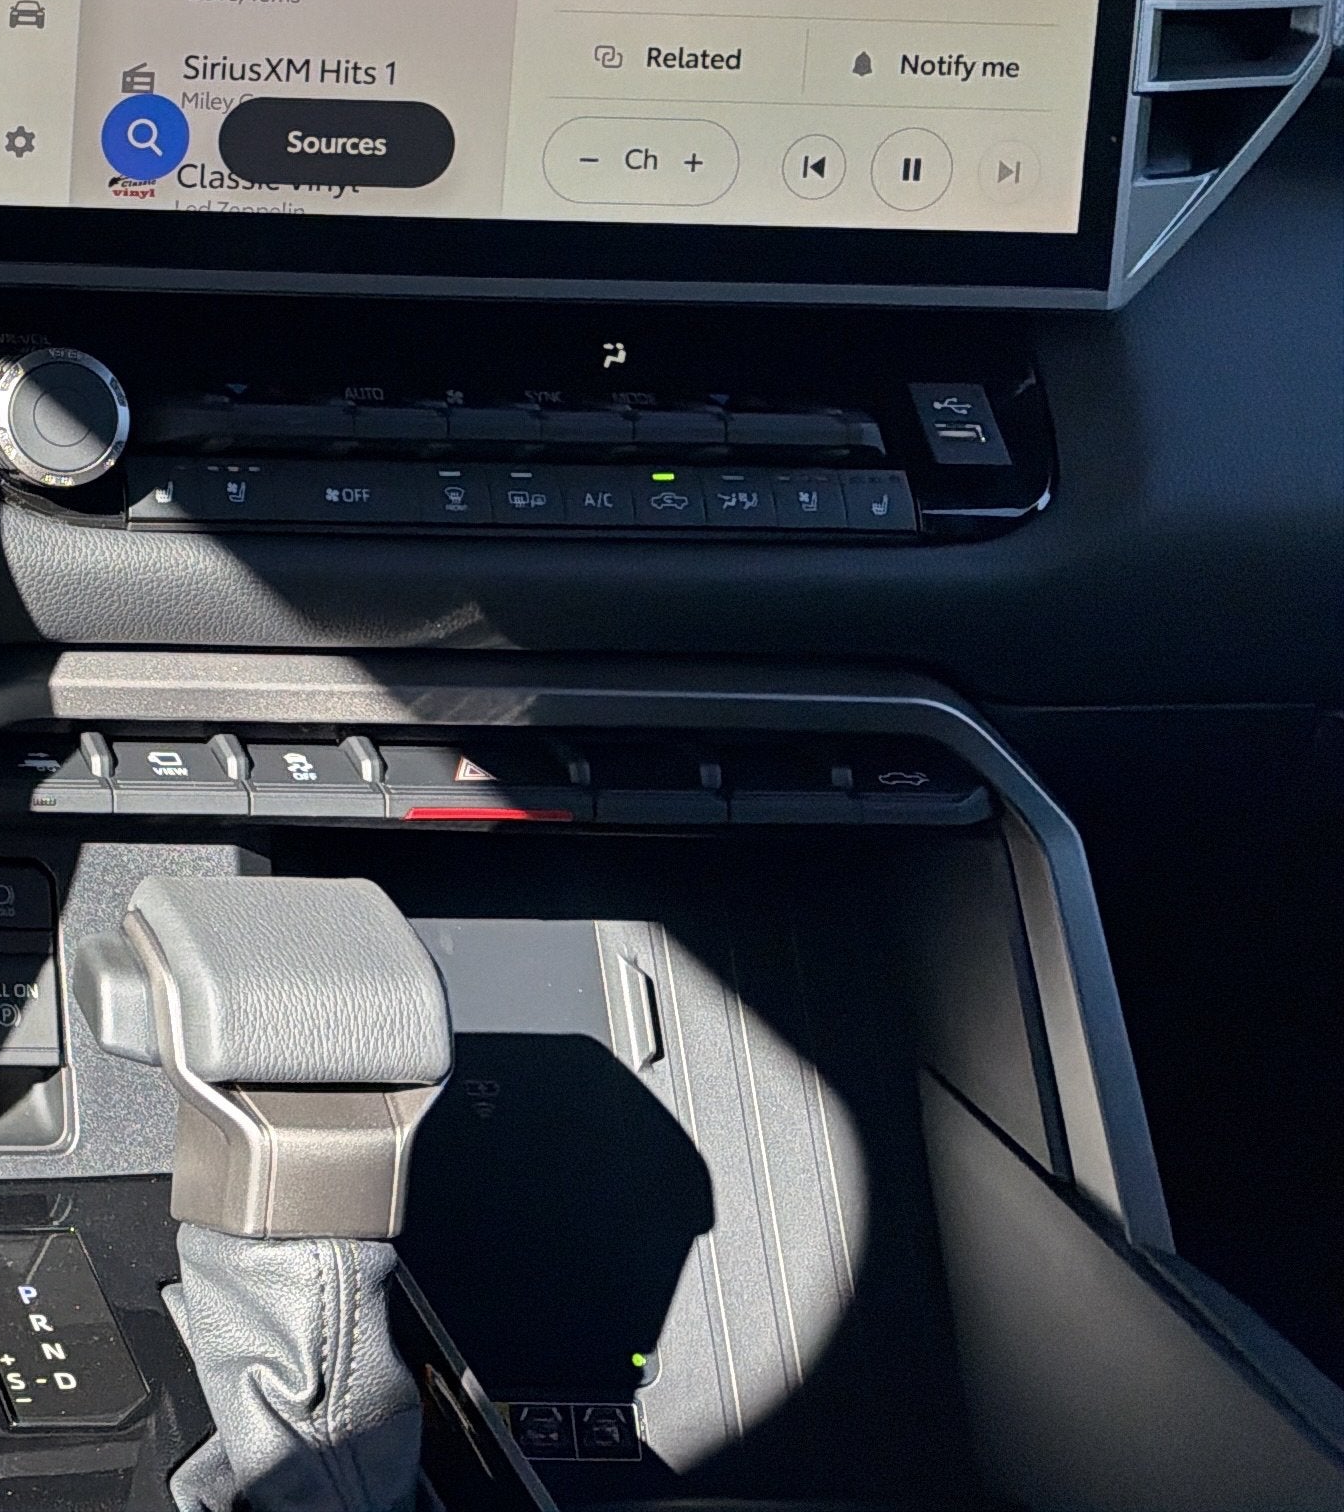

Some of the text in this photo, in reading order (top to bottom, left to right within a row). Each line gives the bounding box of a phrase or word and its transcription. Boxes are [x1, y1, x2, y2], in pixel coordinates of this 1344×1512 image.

[182, 54, 398, 86] SiriusXM Hits 1
[646, 46, 1021, 80] Related Notify me
[181, 91, 234, 115] Miley
[286, 130, 387, 156] Sources
[624, 148, 659, 171] Ch
[111, 188, 156, 199] vinyl
[344, 387, 385, 401] AUTO
[342, 489, 371, 504] OFF
[584, 492, 613, 508] A/C
[152, 767, 190, 777] VIEW
[14, 983, 39, 999] ON
[2, 1008, 12, 1022] P
[17, 1285, 38, 1304] P
[29, 1313, 53, 1333] R
[41, 1342, 67, 1361] N
[6, 1371, 77, 1391] S D
